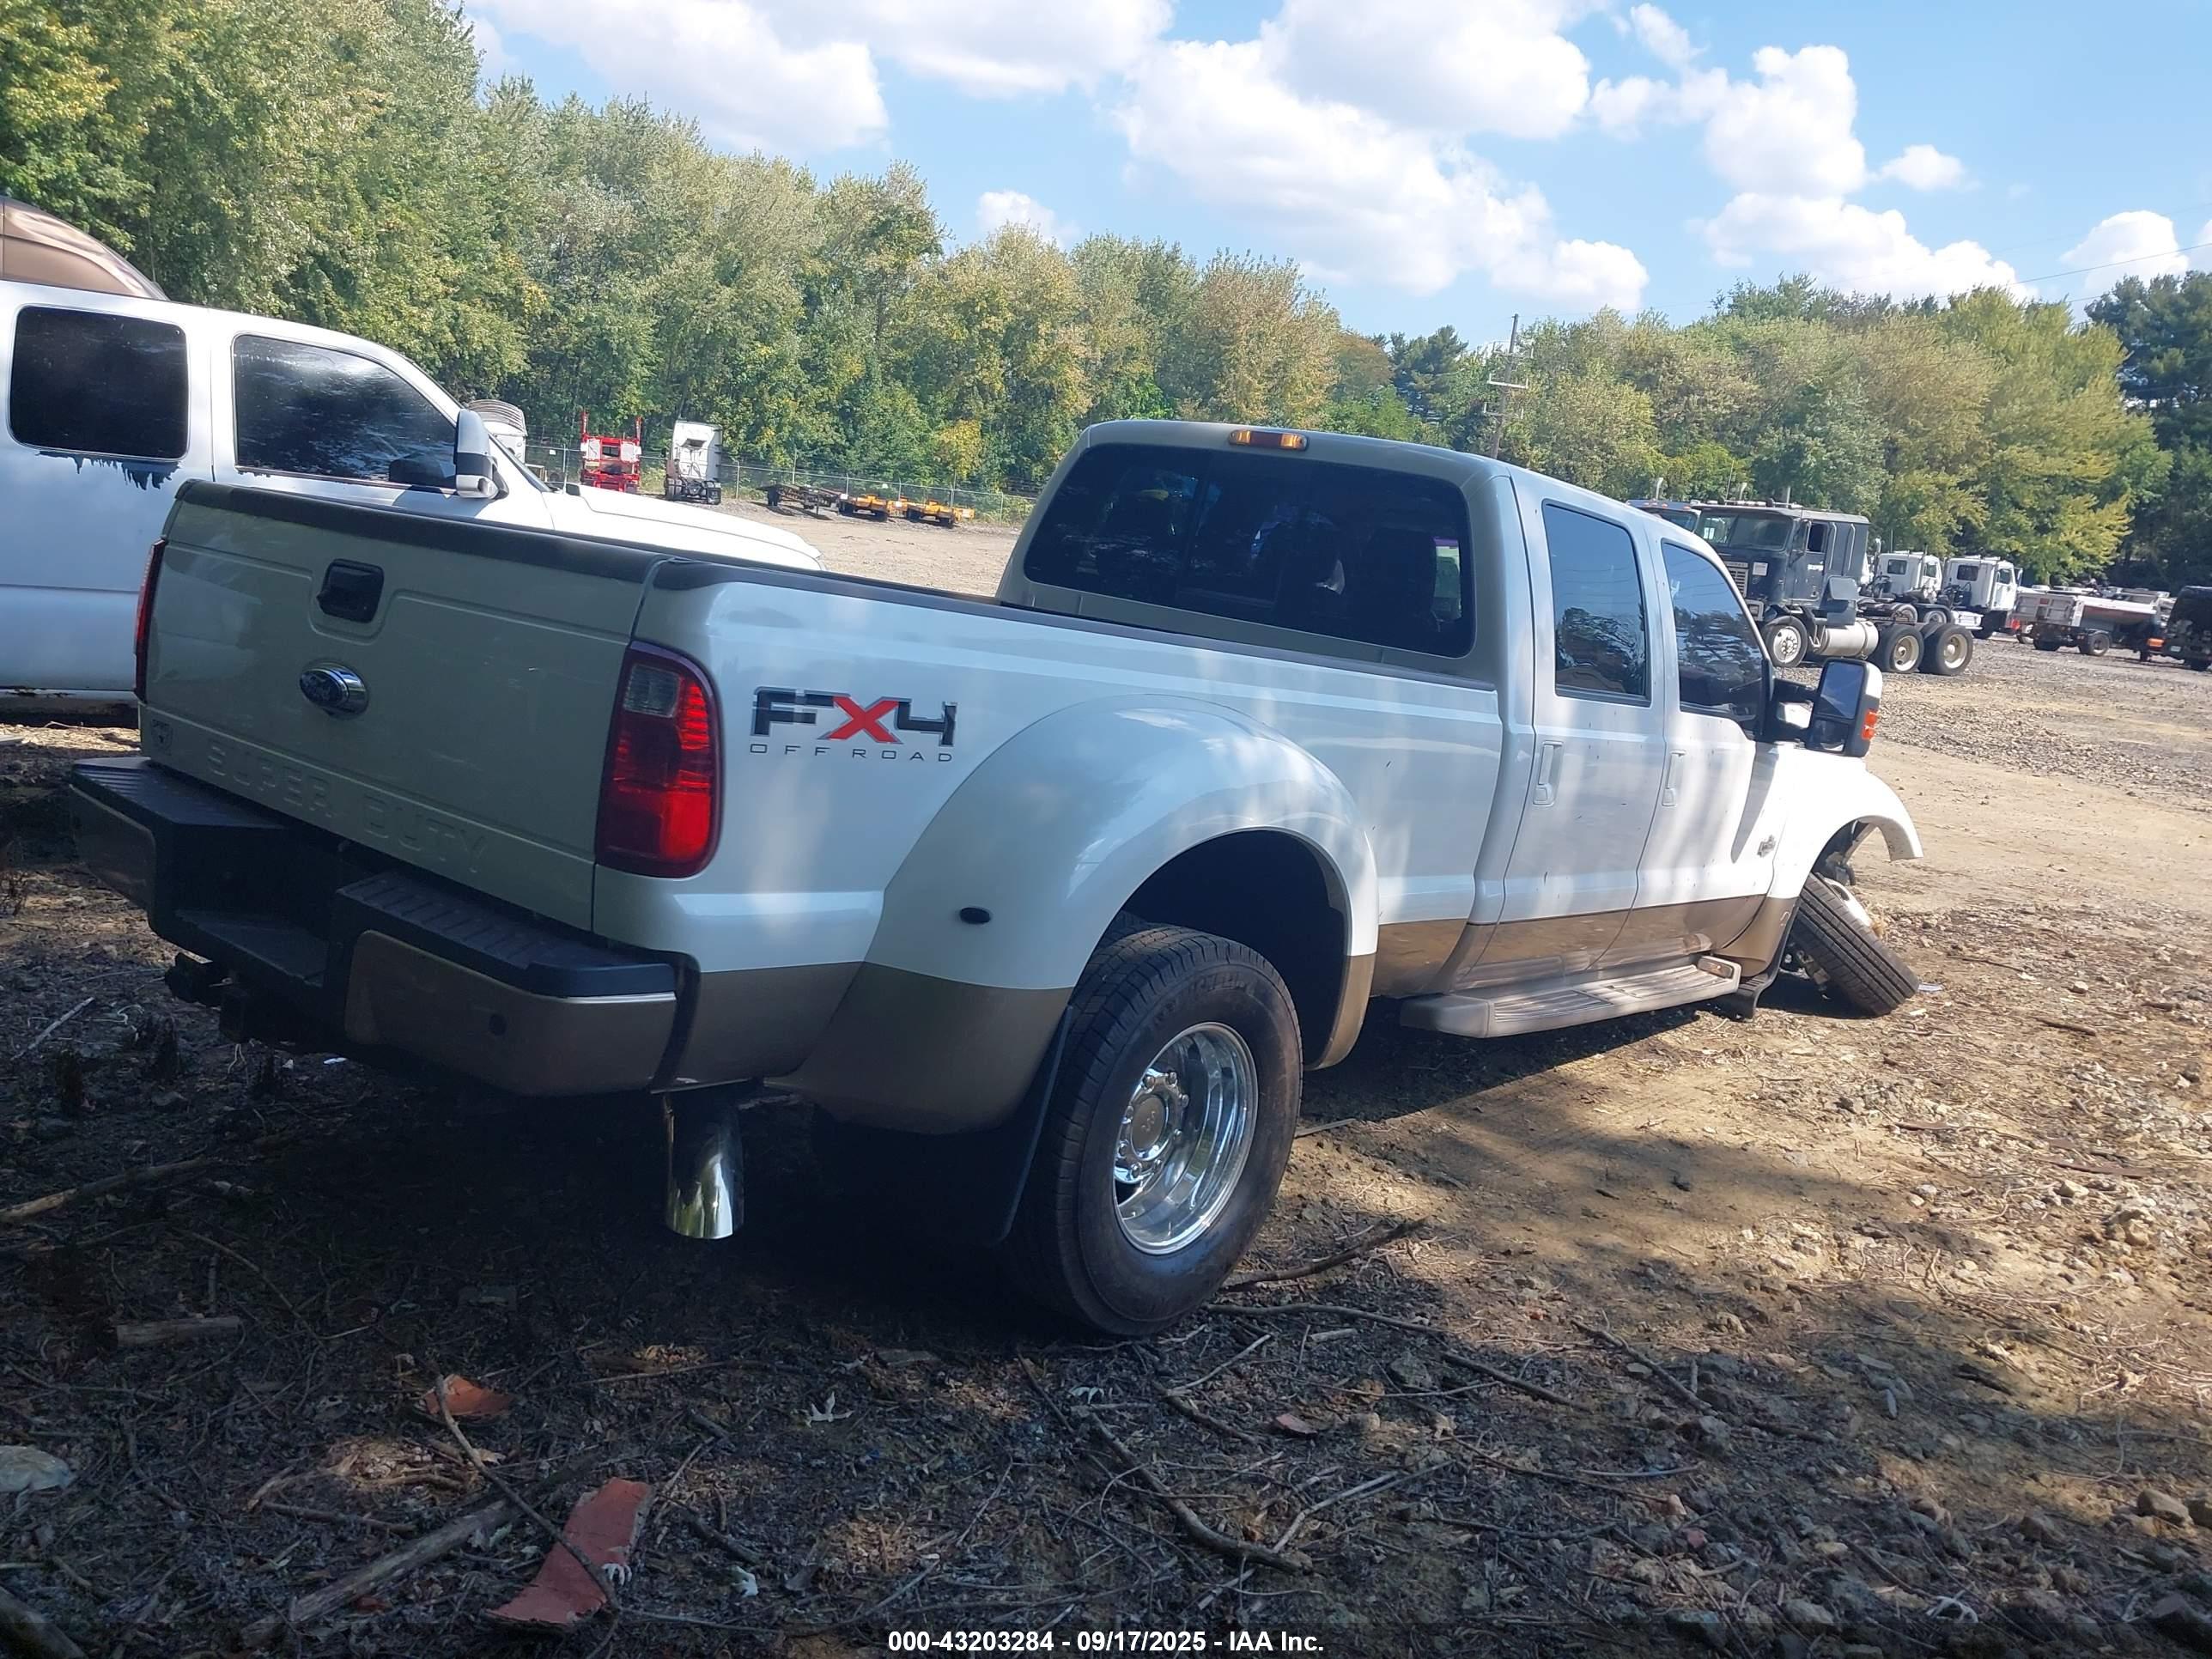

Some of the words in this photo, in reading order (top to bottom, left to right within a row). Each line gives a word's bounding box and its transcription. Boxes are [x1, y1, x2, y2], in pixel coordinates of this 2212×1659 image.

[750, 686, 957, 747] FX4
[206, 738, 337, 818] SUPER
[363, 793, 488, 874] DUTY
